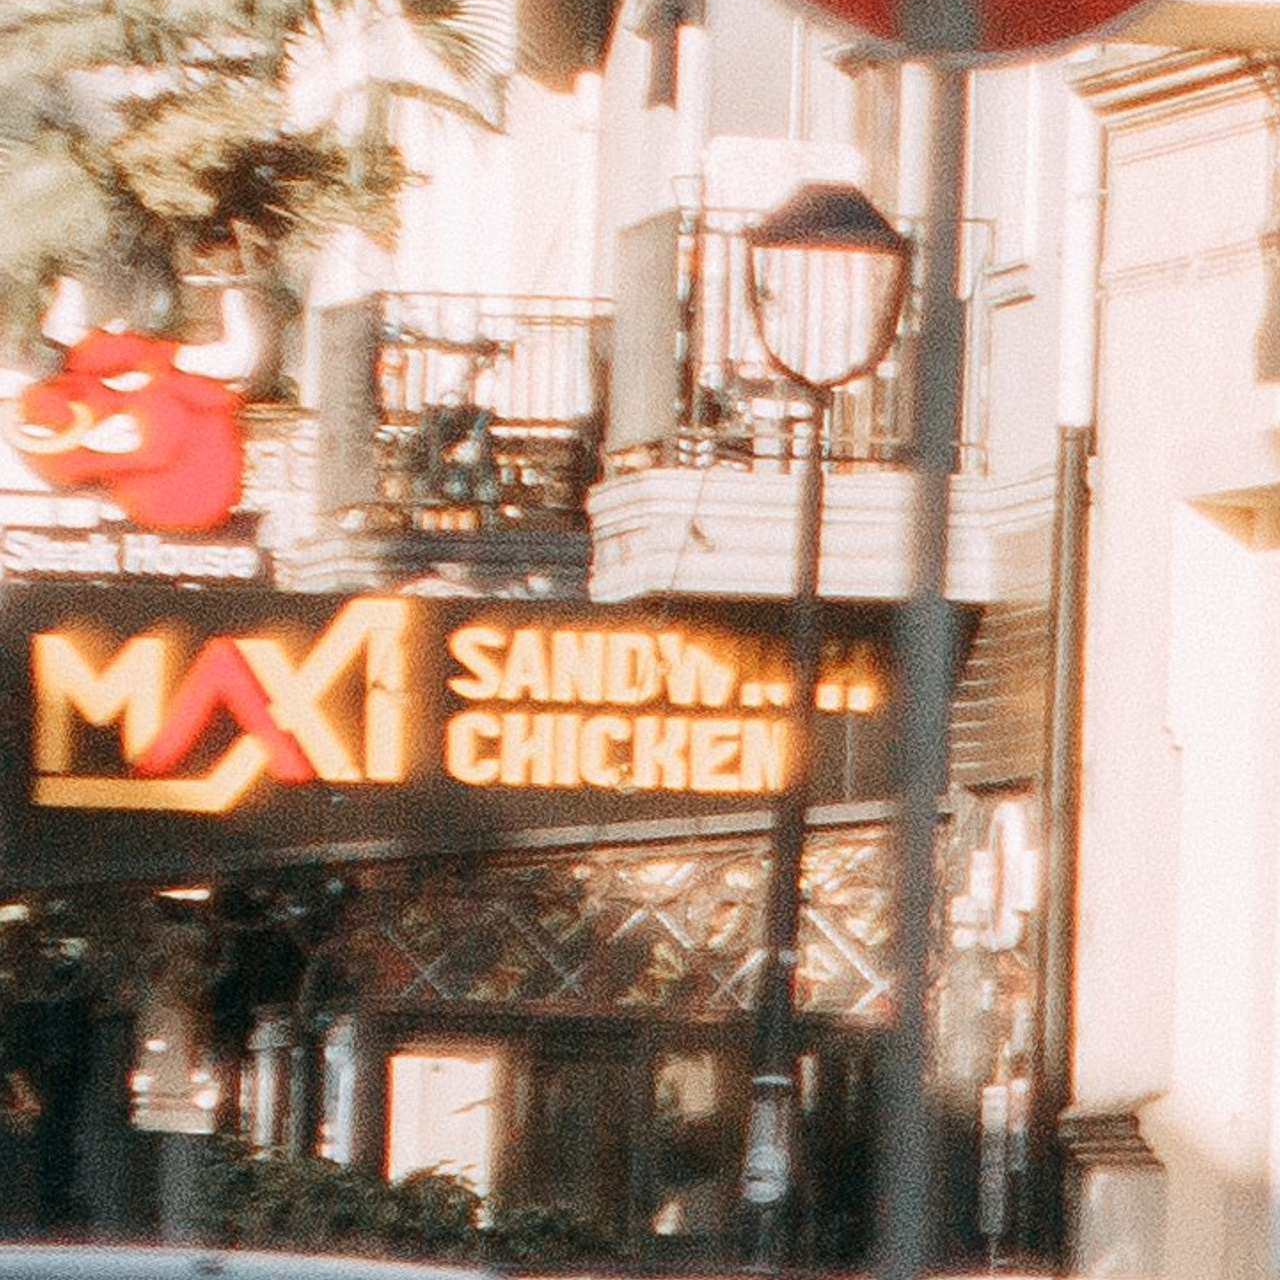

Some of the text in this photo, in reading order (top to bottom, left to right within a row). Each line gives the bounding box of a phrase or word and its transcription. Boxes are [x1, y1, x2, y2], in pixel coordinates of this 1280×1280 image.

[122, 532, 258, 578] House
[32, 597, 408, 786] MAXI
[446, 711, 792, 793] CHICKEN
